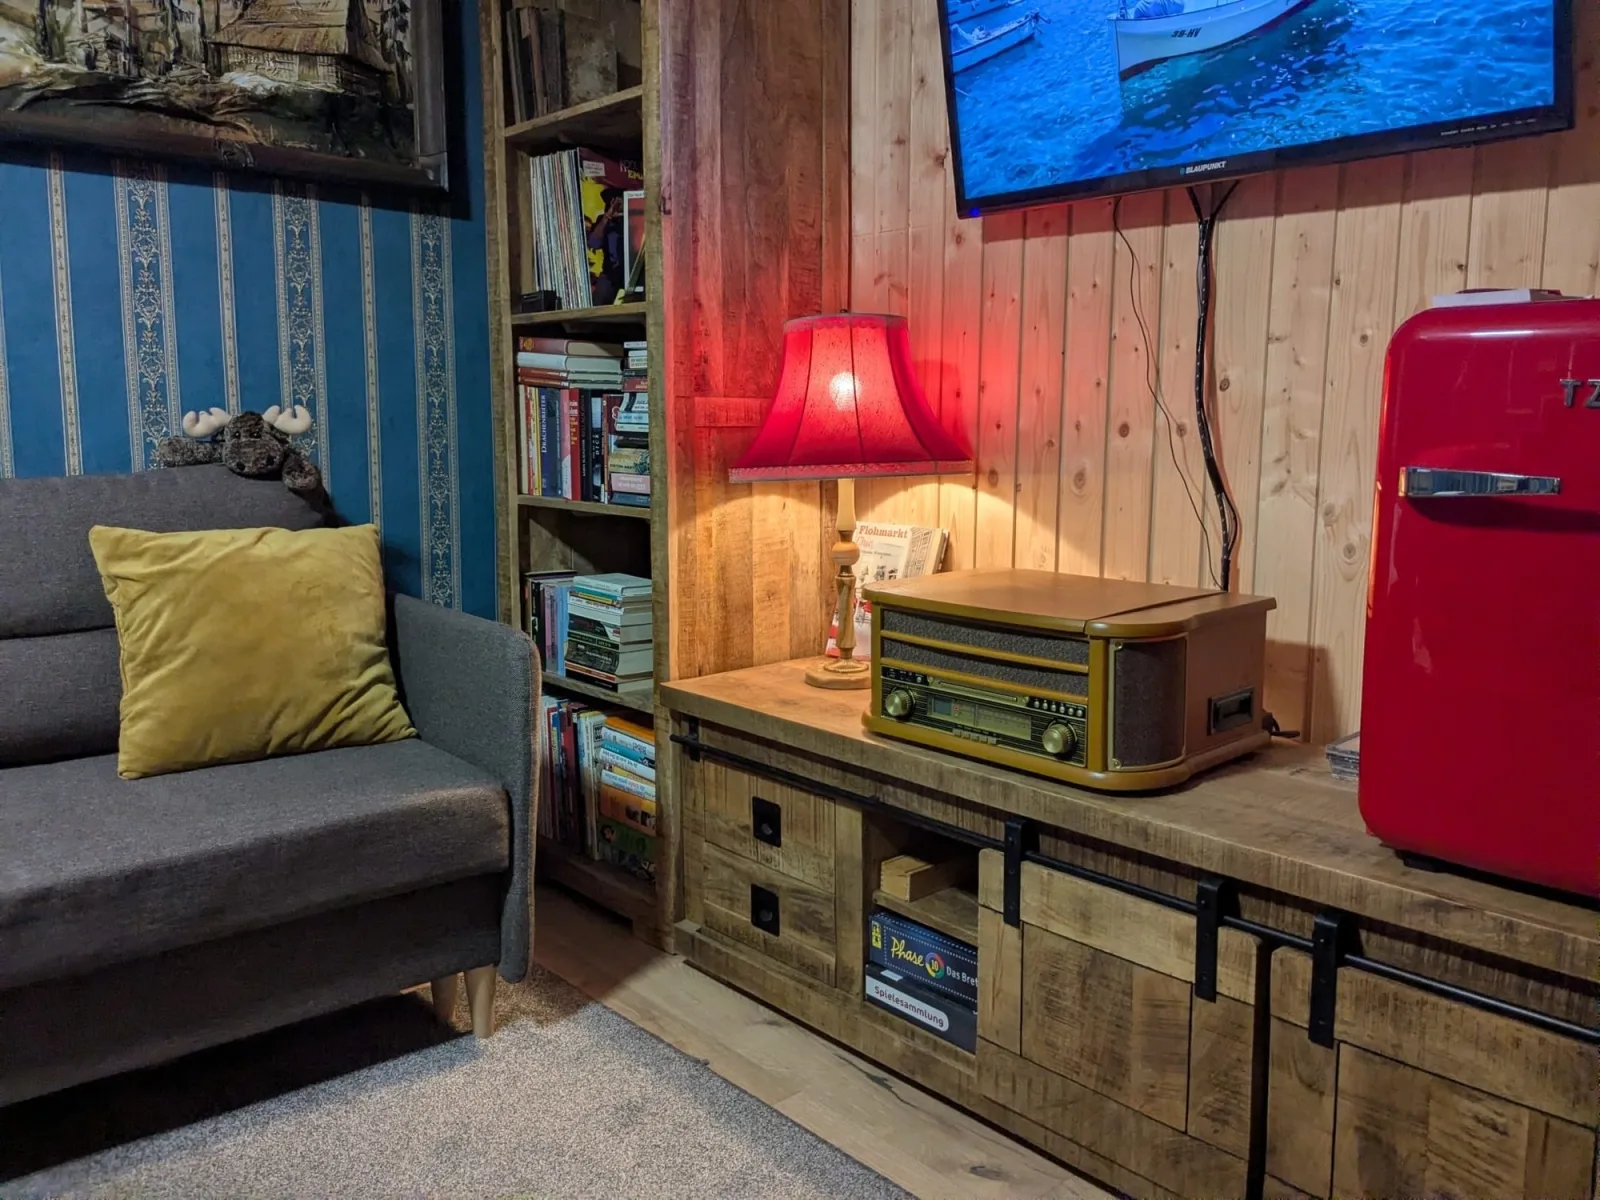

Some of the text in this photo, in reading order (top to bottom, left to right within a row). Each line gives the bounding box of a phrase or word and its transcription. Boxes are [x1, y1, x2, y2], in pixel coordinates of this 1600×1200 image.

[1185, 160, 1227, 174] BLAUPUNKT
[1559, 378, 1600, 409] TZ
[859, 525, 908, 538] Flohmarkt
[890, 936, 924, 967] Phase
[931, 959, 939, 971] 10
[946, 965, 961, 981] Das
[874, 985, 945, 1028] Spielesammlung
